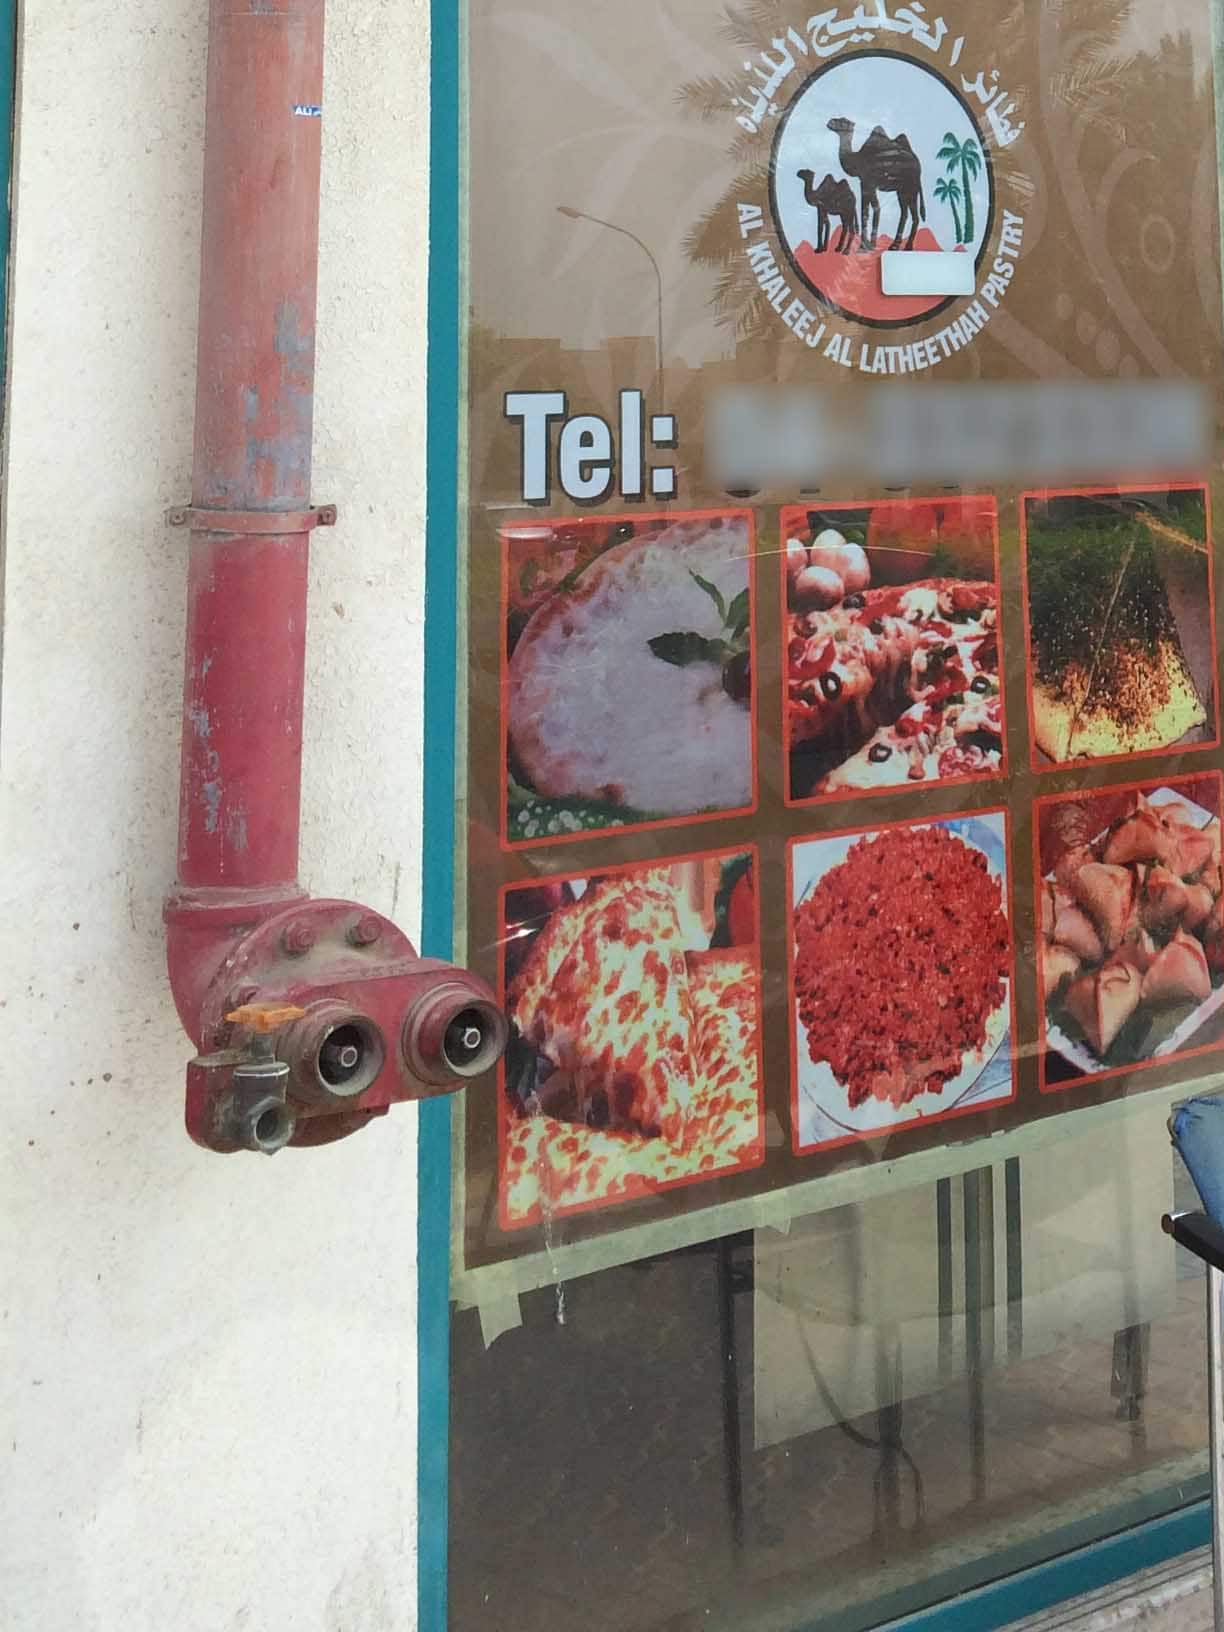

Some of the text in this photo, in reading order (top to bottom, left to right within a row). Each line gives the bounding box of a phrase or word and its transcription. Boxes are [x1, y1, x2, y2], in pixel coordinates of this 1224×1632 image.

[736, 202, 1025, 375] AL KHALEEJ AL LATHEETHAH PASTRY
[504, 388, 678, 502] Tel:
